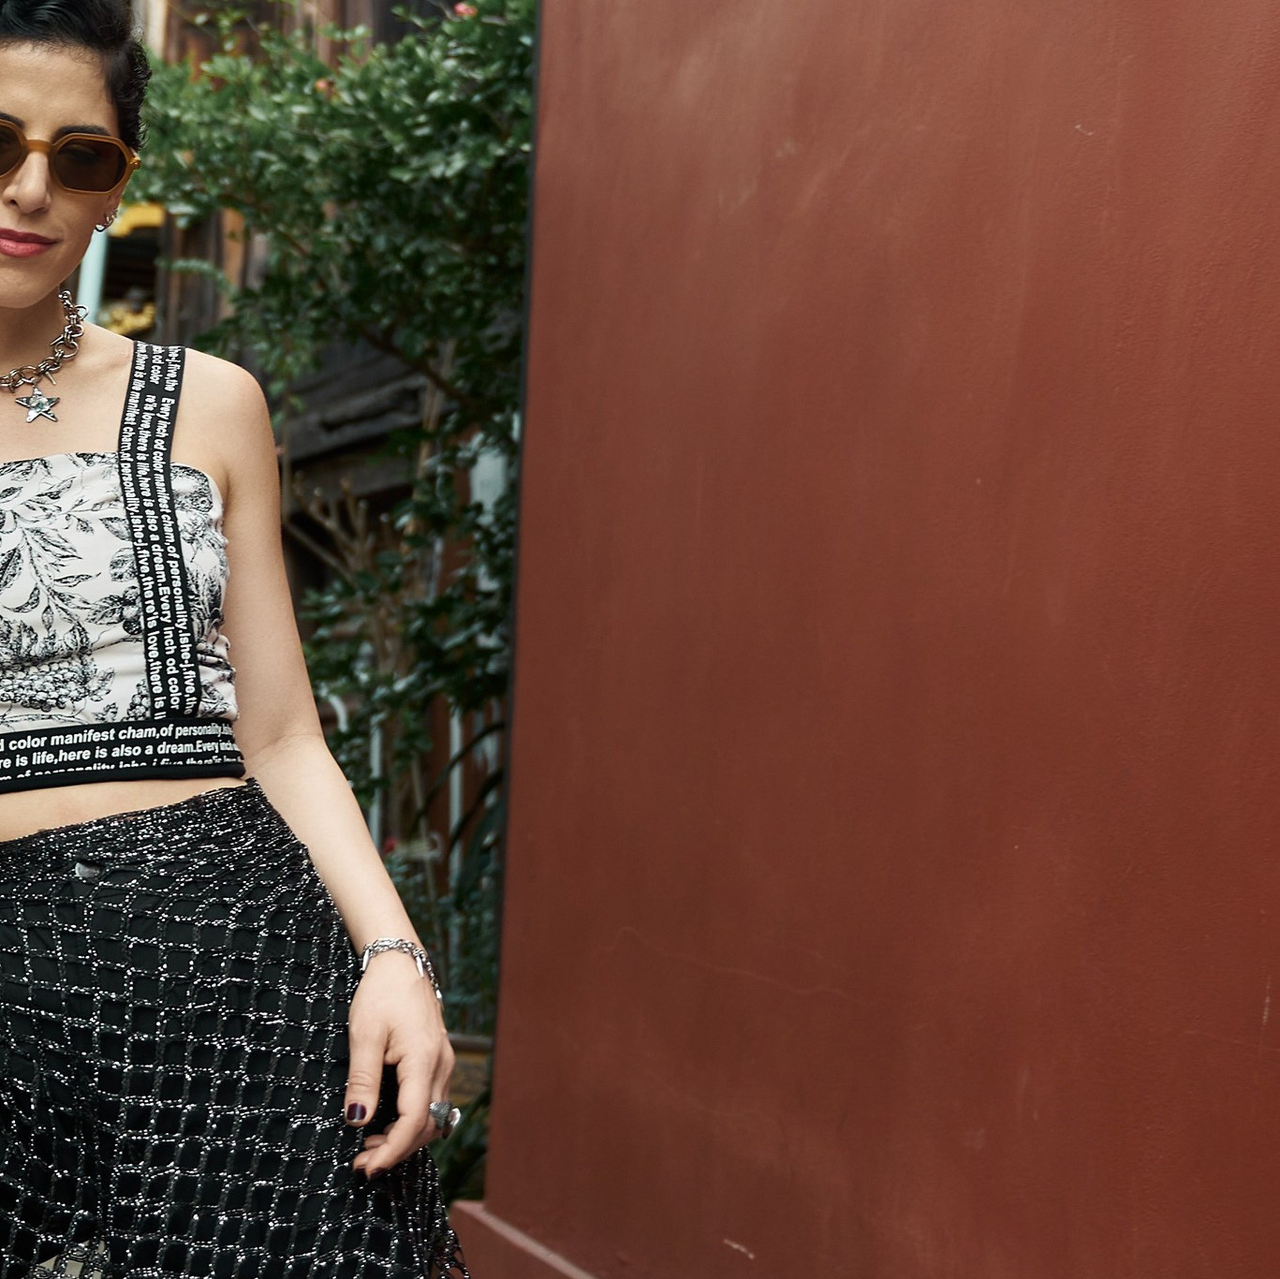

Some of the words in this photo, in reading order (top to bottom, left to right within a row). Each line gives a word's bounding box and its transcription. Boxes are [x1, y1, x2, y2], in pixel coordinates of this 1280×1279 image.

[151, 354, 165, 364] od
[133, 370, 147, 378] is
[149, 364, 163, 385] color
[131, 378, 146, 391] life
[124, 391, 140, 425] manifest
[155, 397, 176, 420] Every
[155, 420, 171, 438] inch
[153, 438, 167, 451] od
[136, 452, 149, 462] is
[152, 451, 166, 473] color
[153, 473, 172, 513] manifest
[142, 498, 155, 508] is
[145, 509, 159, 531] also
[149, 534, 160, 542] a
[163, 626, 177, 655] inch
[165, 657, 180, 675] od
[153, 695, 167, 709] is
[167, 677, 182, 710] color
[8, 735, 48, 751] color
[50, 728, 116, 746] manifest
[15, 754, 28, 767] is
[94, 745, 108, 759] is
[111, 744, 141, 757] also
[144, 745, 154, 755] a
